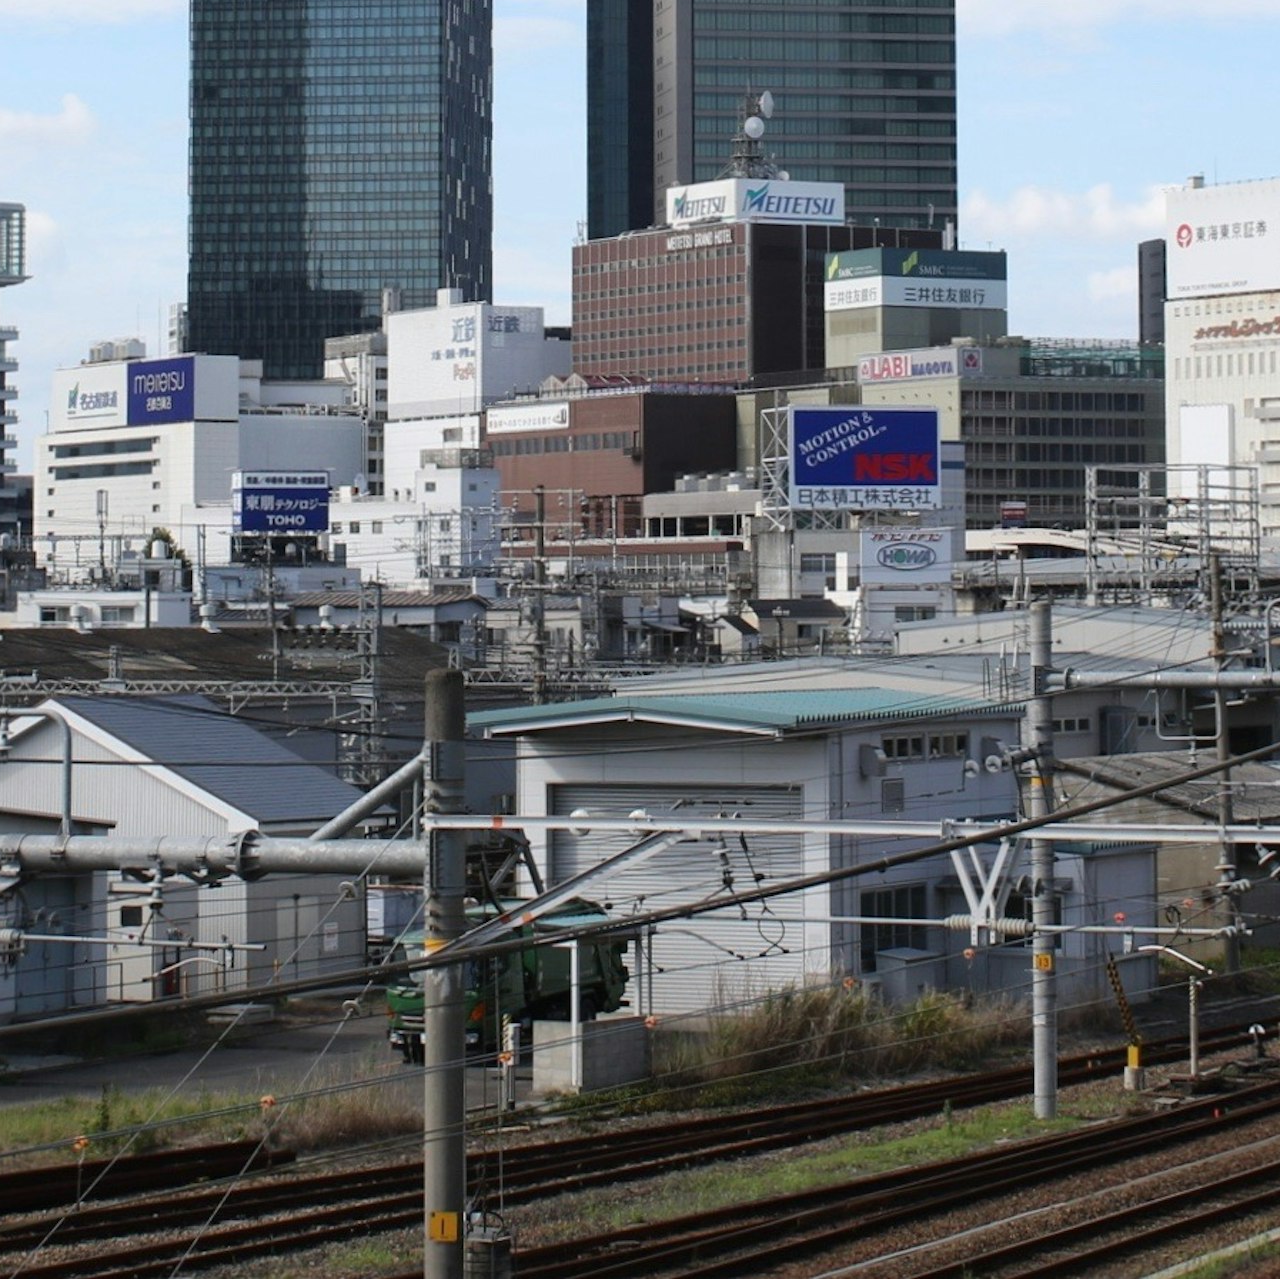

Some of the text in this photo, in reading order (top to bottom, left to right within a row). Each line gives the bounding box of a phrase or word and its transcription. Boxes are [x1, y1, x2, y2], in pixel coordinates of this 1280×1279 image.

[742, 182, 836, 216] MEITETSU
[1195, 220, 1268, 242] 東海東京証券
[920, 266, 945, 276] SMBC
[829, 287, 878, 306] 三井住友銀行
[904, 287, 986, 305] 三井住友銀行
[870, 355, 912, 379] LABI
[798, 411, 874, 455] MOTION &
[854, 452, 936, 482] NSK
[799, 488, 932, 505] 日本精工株式会社
[266, 514, 306, 526] TOHO
[882, 548, 932, 564] HOWA
